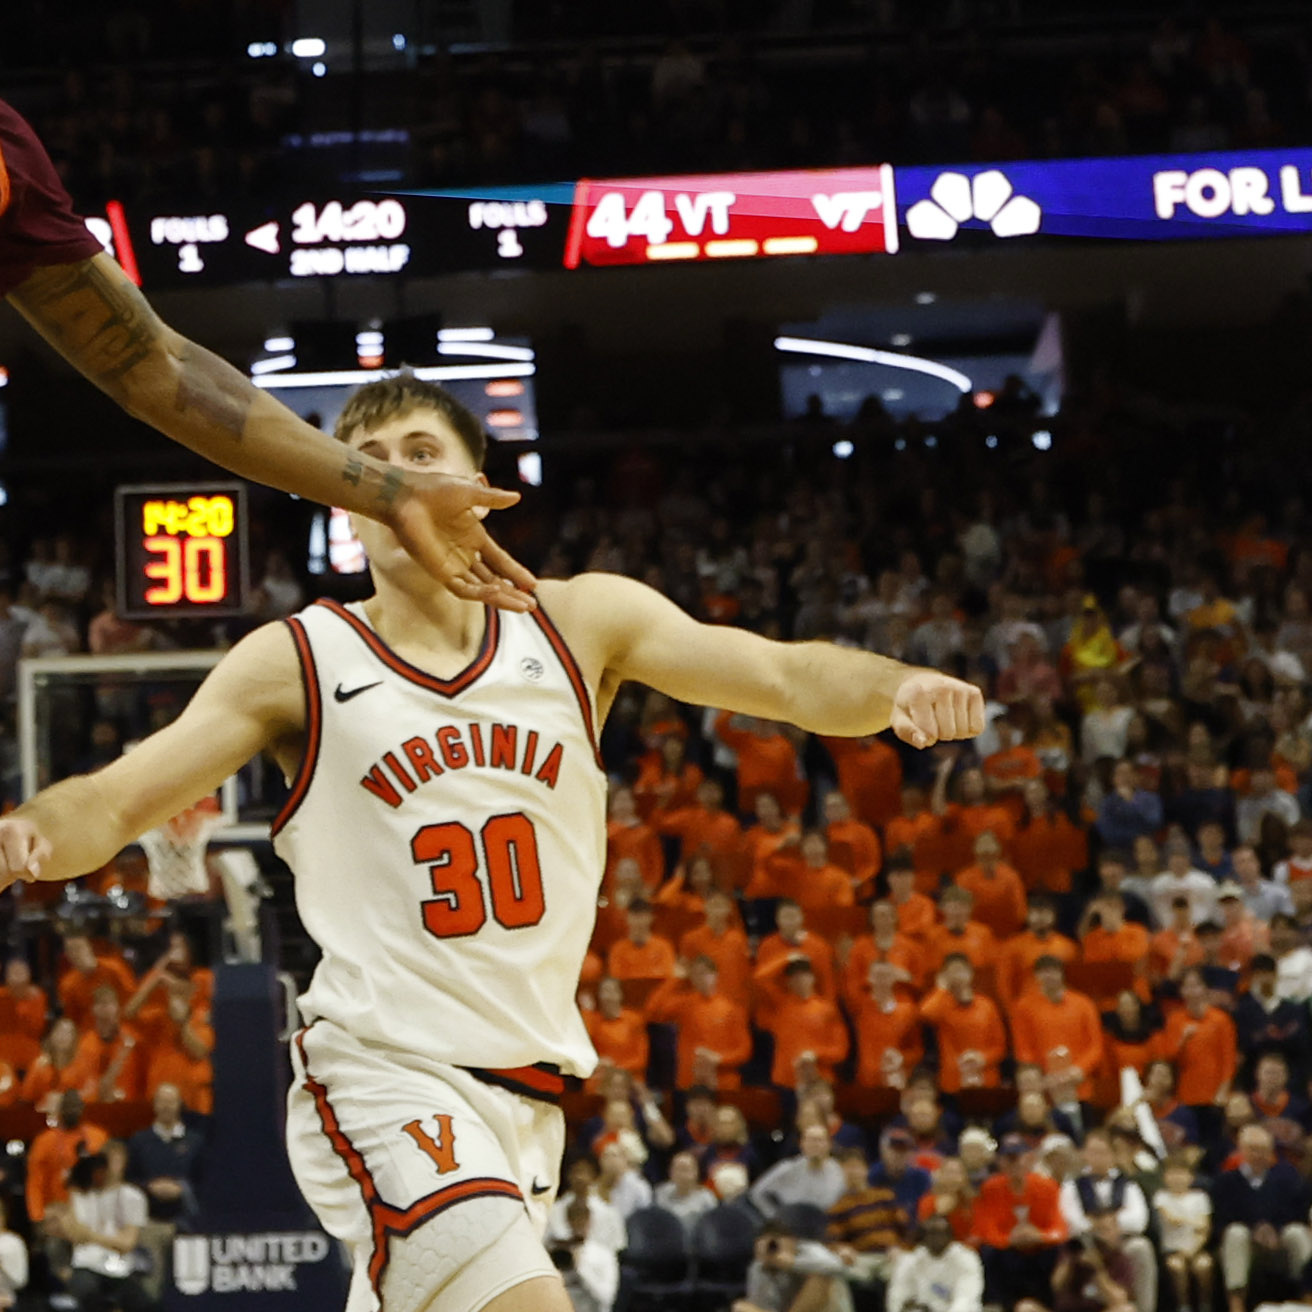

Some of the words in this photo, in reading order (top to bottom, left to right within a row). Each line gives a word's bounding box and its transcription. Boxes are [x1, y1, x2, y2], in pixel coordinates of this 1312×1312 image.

[1153, 167, 1275, 220] FOR
[1280, 164, 1312, 213] L
[151, 214, 229, 244] FOULS
[291, 199, 406, 243] 14:20
[469, 200, 548, 230] FOULS
[586, 191, 673, 248] 44
[675, 191, 736, 236] VT
[178, 244, 204, 273] 1
[497, 228, 523, 258] 1
[143, 495, 234, 537] 14:20
[143, 536, 226, 605] 30
[359, 722, 565, 809] VIRGINIA
[410, 811, 545, 939] 30
[401, 1114, 461, 1175] V
[210, 1233, 329, 1264] UNITED
[212, 1262, 297, 1293] BANK
